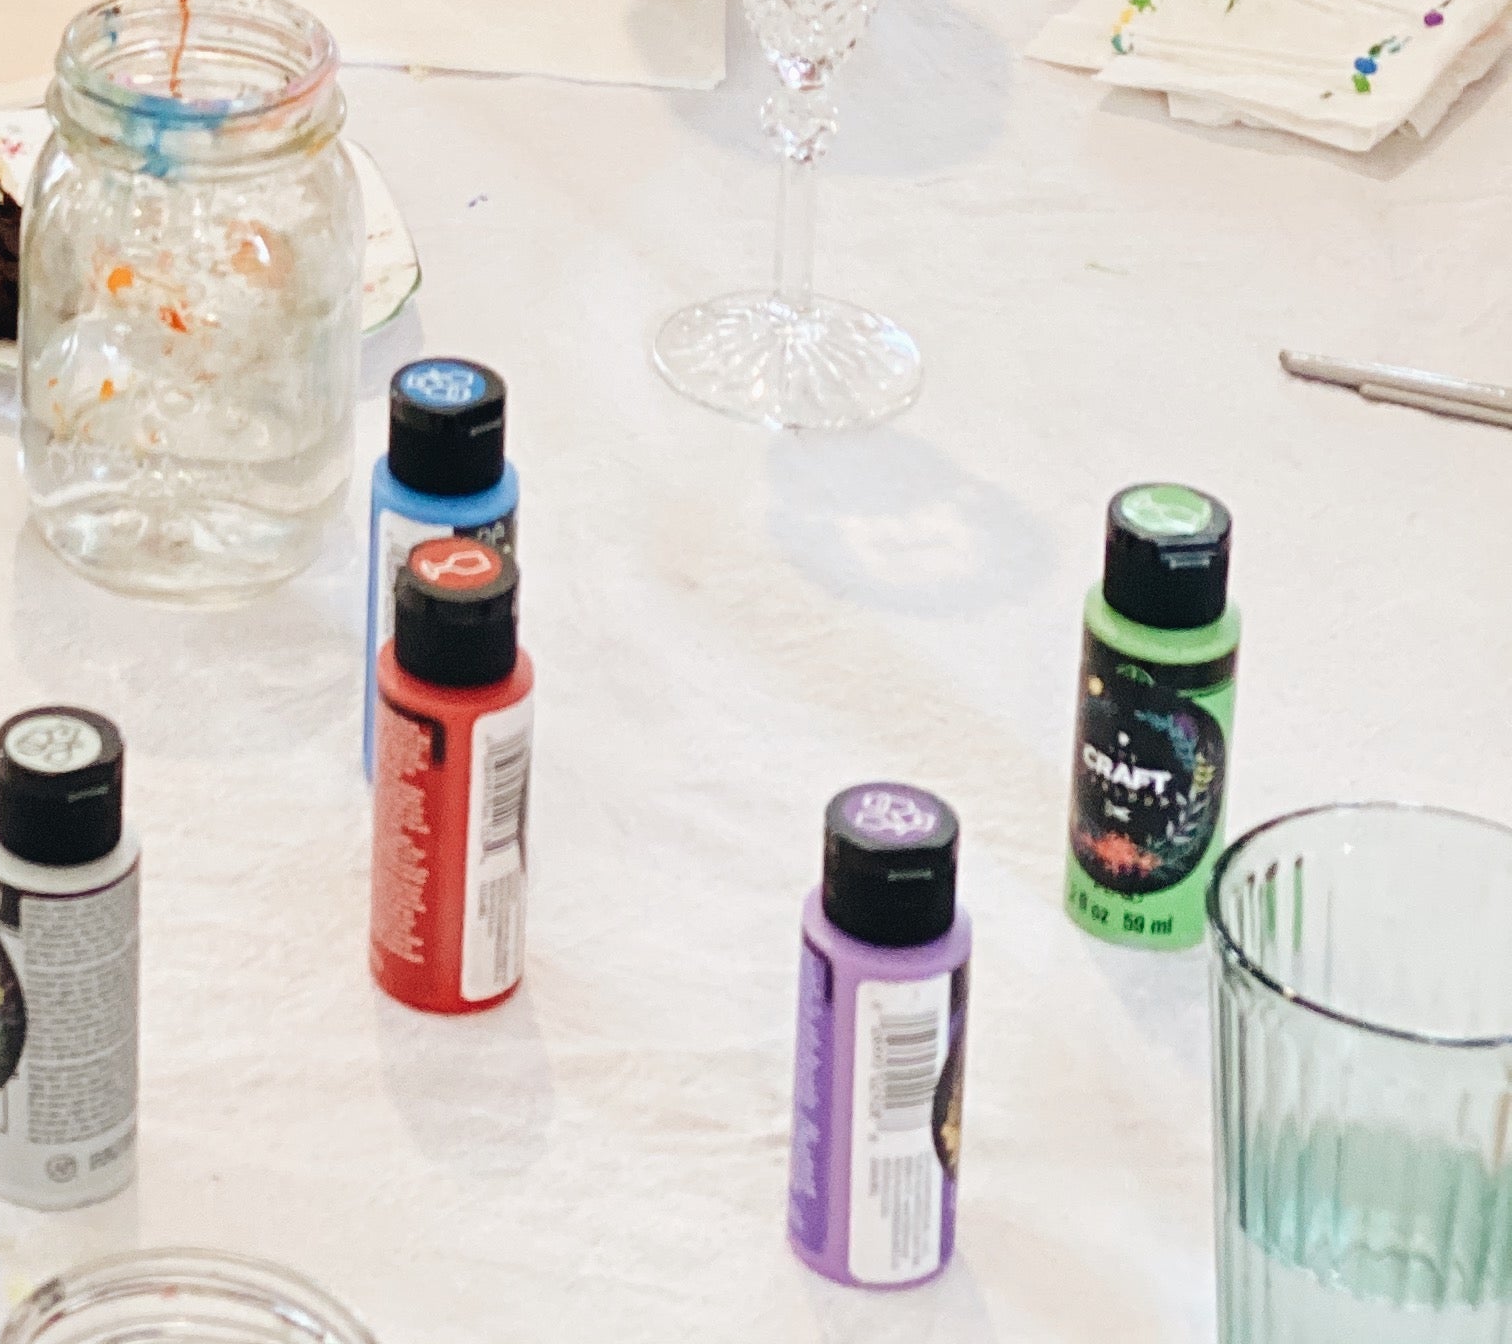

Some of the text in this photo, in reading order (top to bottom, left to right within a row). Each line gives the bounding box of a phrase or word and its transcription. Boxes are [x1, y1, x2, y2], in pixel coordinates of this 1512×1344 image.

[1083, 742, 1173, 795] CRAFT
[1123, 910, 1145, 934] 59
[1150, 914, 1173, 935] ml
